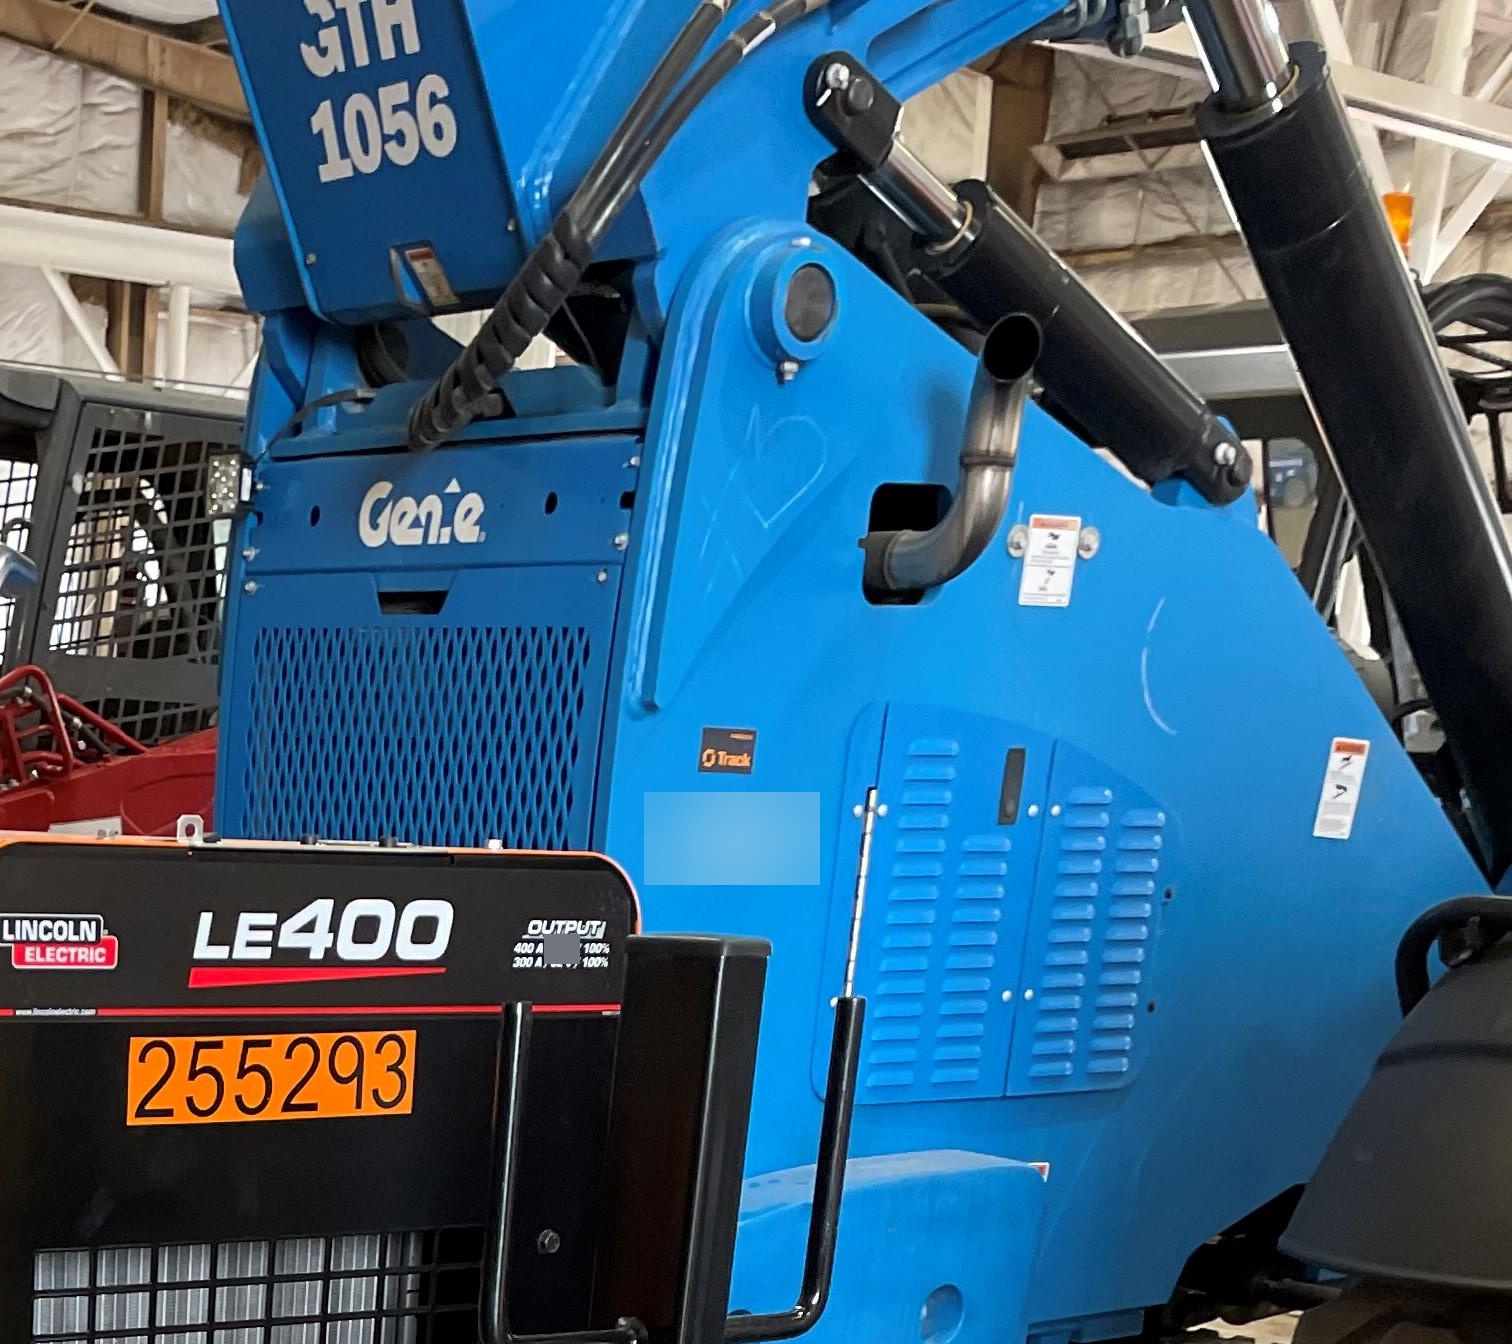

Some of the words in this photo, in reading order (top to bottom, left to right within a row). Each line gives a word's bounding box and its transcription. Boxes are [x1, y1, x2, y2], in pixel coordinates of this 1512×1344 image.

[300, 0, 421, 78] GTH
[310, 73, 458, 183] 1056
[359, 477, 486, 548] Genie
[2, 919, 97, 942] LINCOLN
[24, 946, 107, 963] ELECTRIC
[193, 898, 454, 961] LE400
[134, 1033, 408, 1119] 255293
